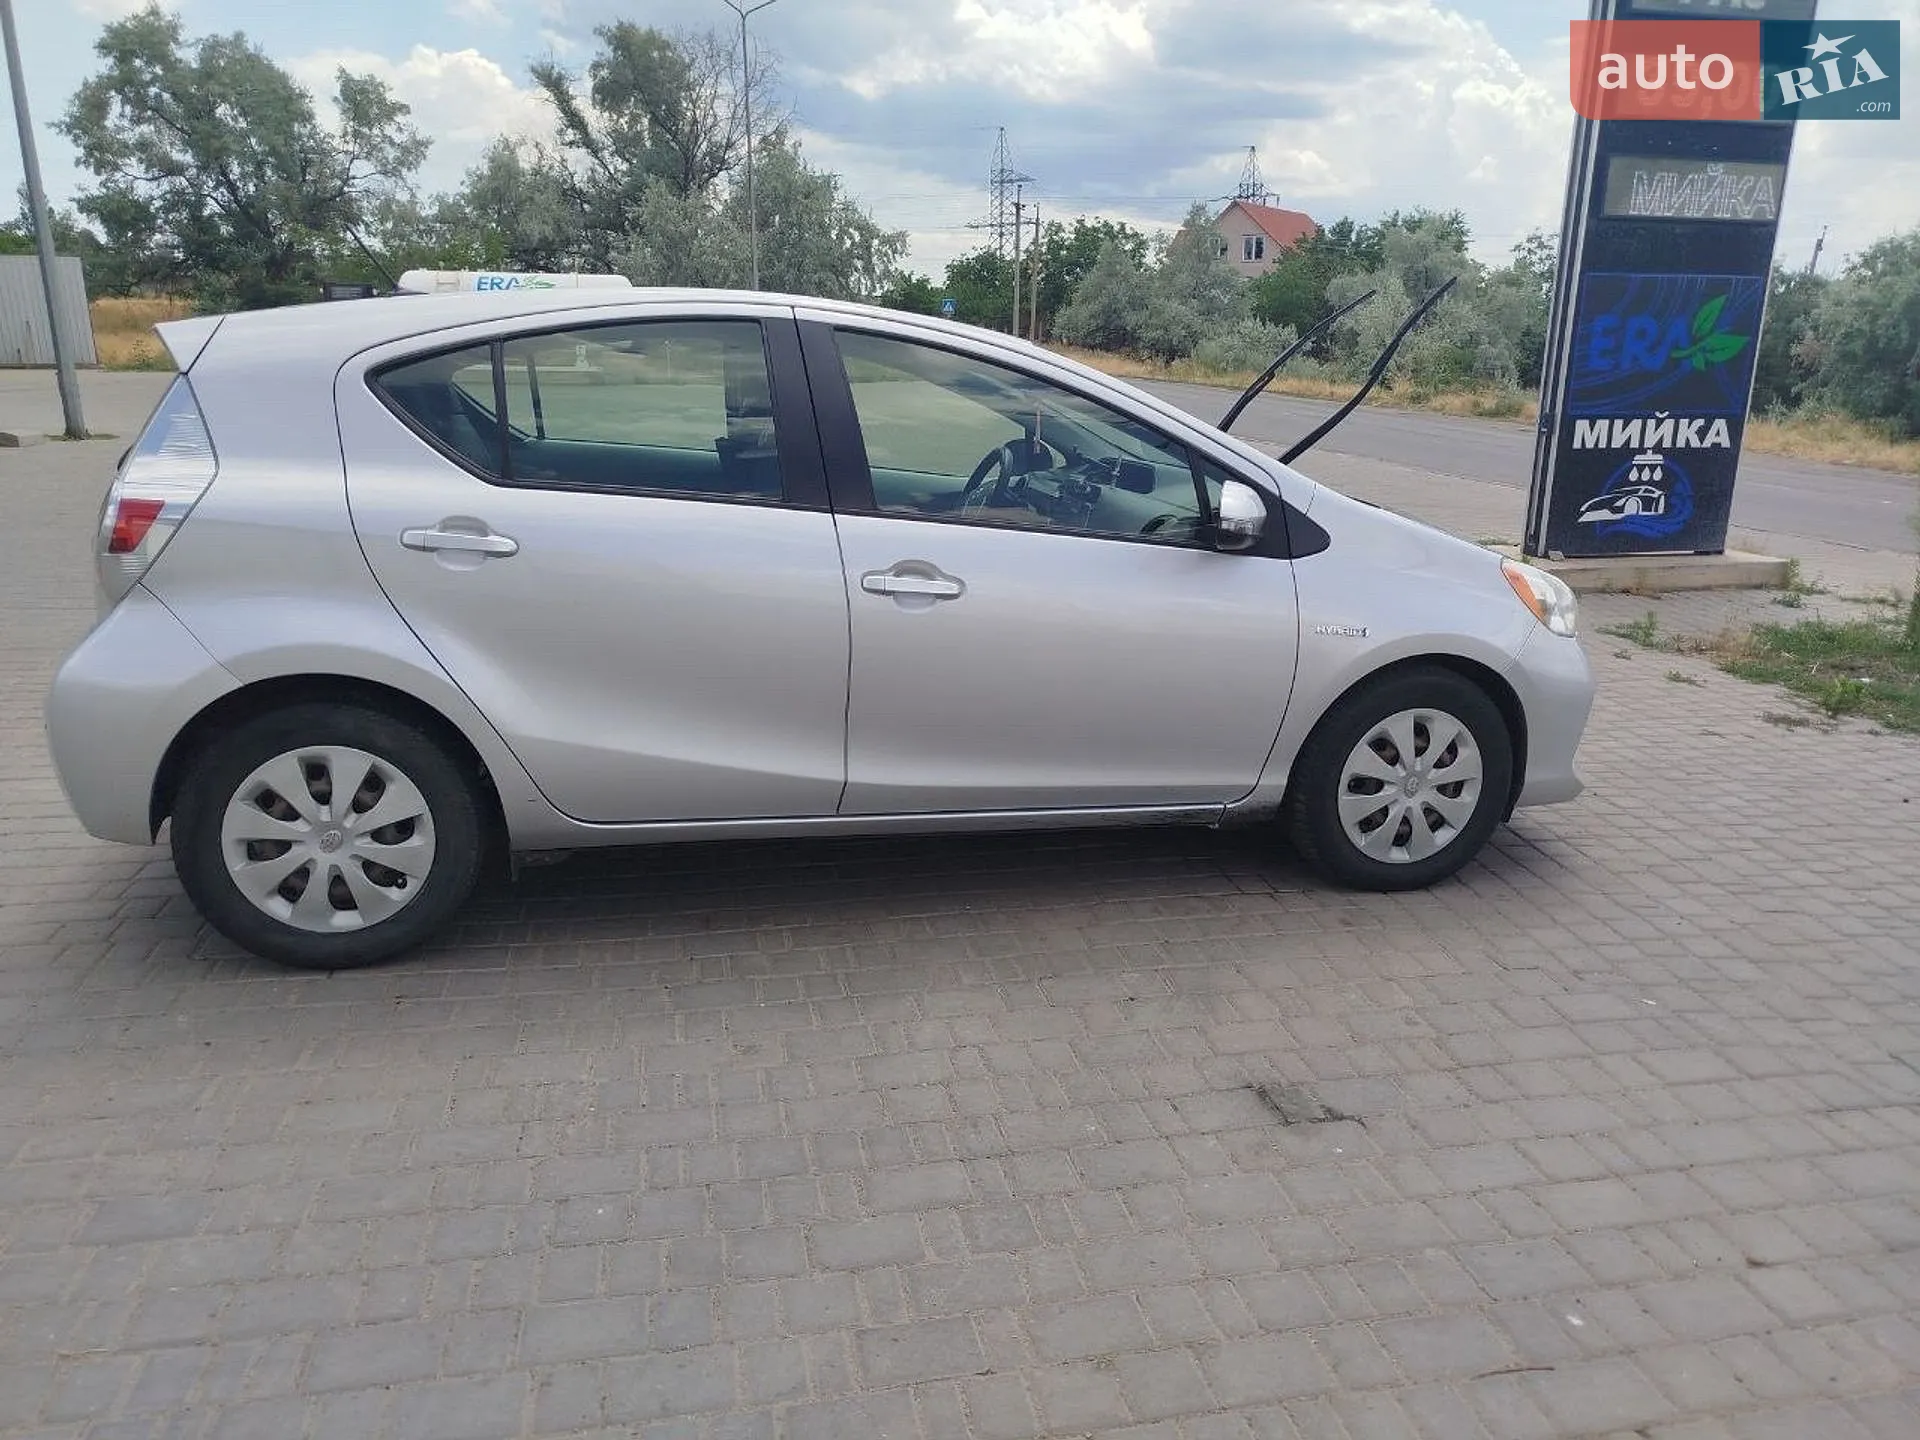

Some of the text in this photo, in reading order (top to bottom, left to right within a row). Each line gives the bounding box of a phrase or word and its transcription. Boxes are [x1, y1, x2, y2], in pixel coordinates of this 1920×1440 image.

[1629, 161, 1776, 219] МИЙКА
[1587, 313, 1694, 370] ERA
[1572, 411, 1731, 449] МИЙКА
